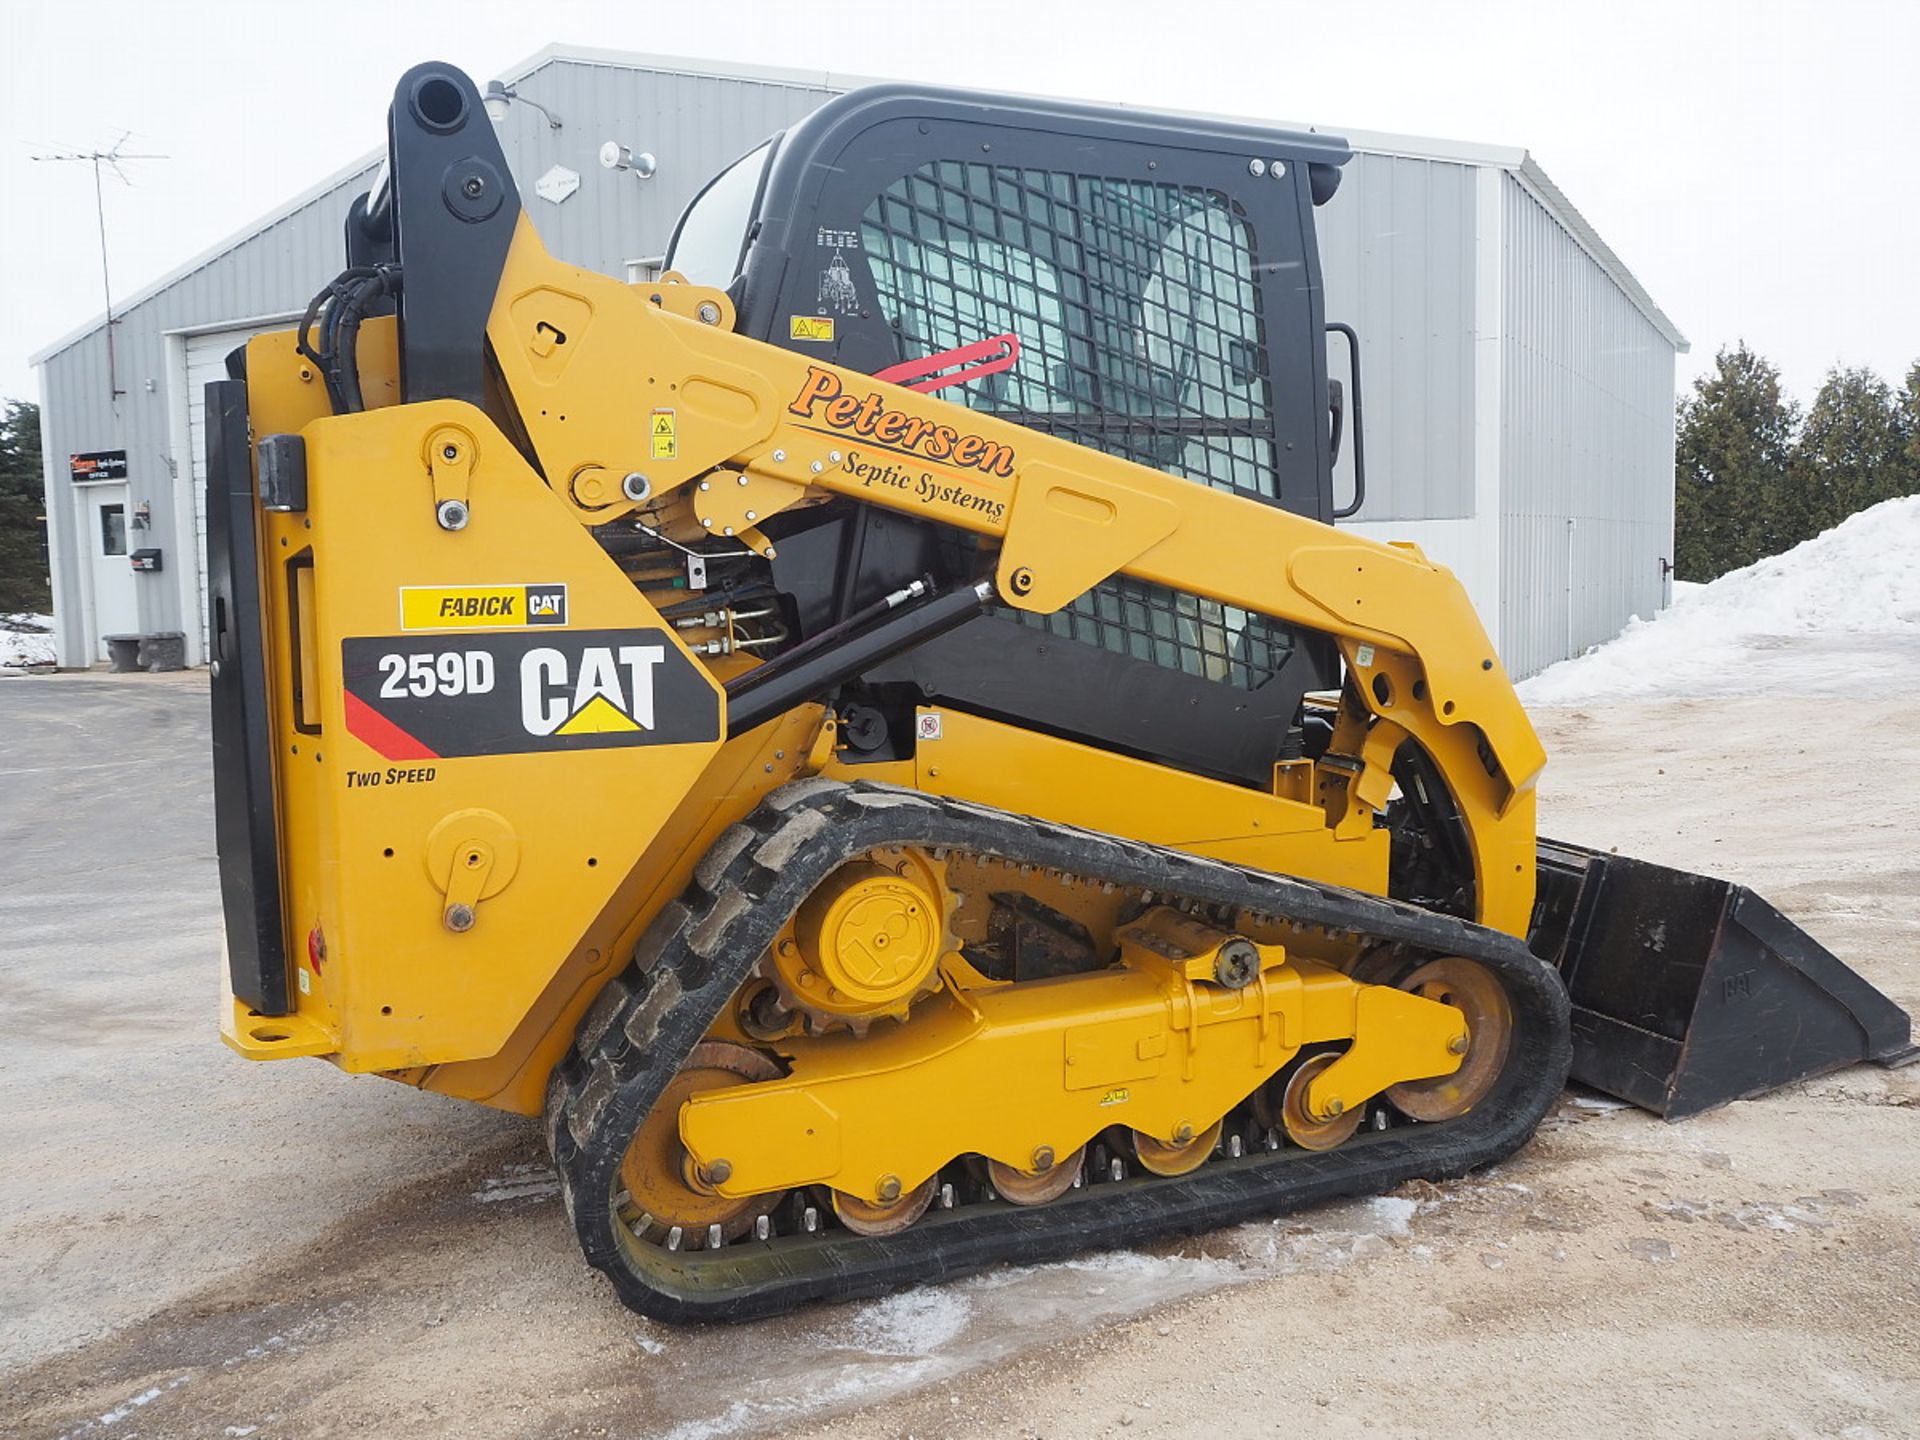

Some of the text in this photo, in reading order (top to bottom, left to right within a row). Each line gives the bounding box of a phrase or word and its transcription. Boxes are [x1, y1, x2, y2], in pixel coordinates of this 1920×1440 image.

[788, 366, 1014, 477] Petersen
[841, 451, 1005, 518] Septic Systems
[439, 596, 516, 617] FABICK
[528, 594, 563, 615] CAT
[378, 650, 496, 699] 259D
[520, 645, 665, 737] CAT
